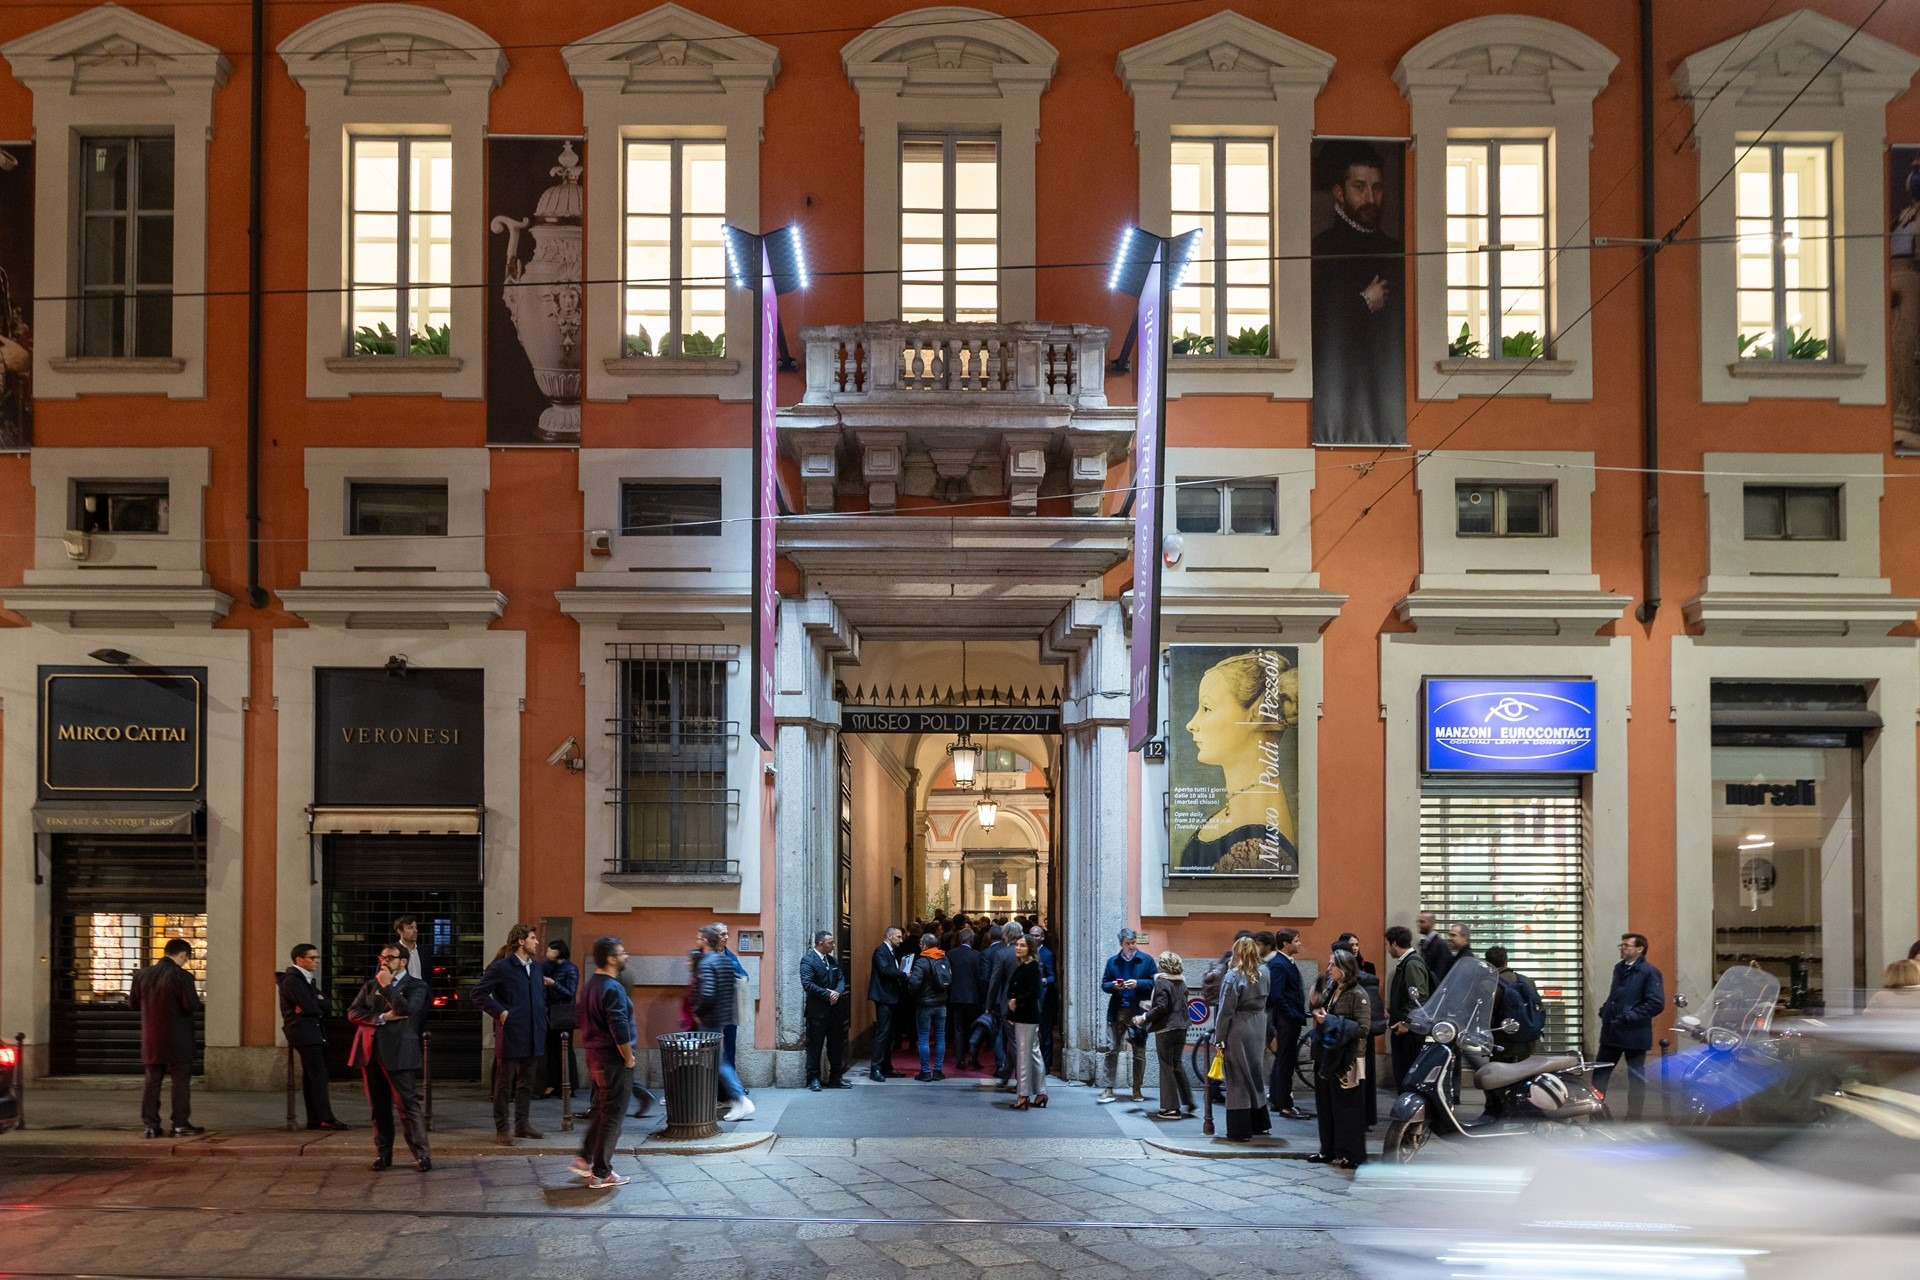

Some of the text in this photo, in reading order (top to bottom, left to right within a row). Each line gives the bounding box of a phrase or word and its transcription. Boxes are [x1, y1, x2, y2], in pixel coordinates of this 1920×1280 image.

[1138, 305, 1154, 622] Museo Poldi Pezzoli
[852, 714, 1049, 731] MUSEO POLDI PEZZOLI
[58, 724, 186, 742] MIRCO CATTAI
[341, 727, 461, 745] VERONESI
[1435, 726, 1592, 739] MANZONI EUROCONTACT
[1148, 742, 1162, 756] 12
[1258, 652, 1280, 867] Museo Poldi Pezzoli
[92, 817, 100, 826] &
[149, 817, 174, 826] RUGS
